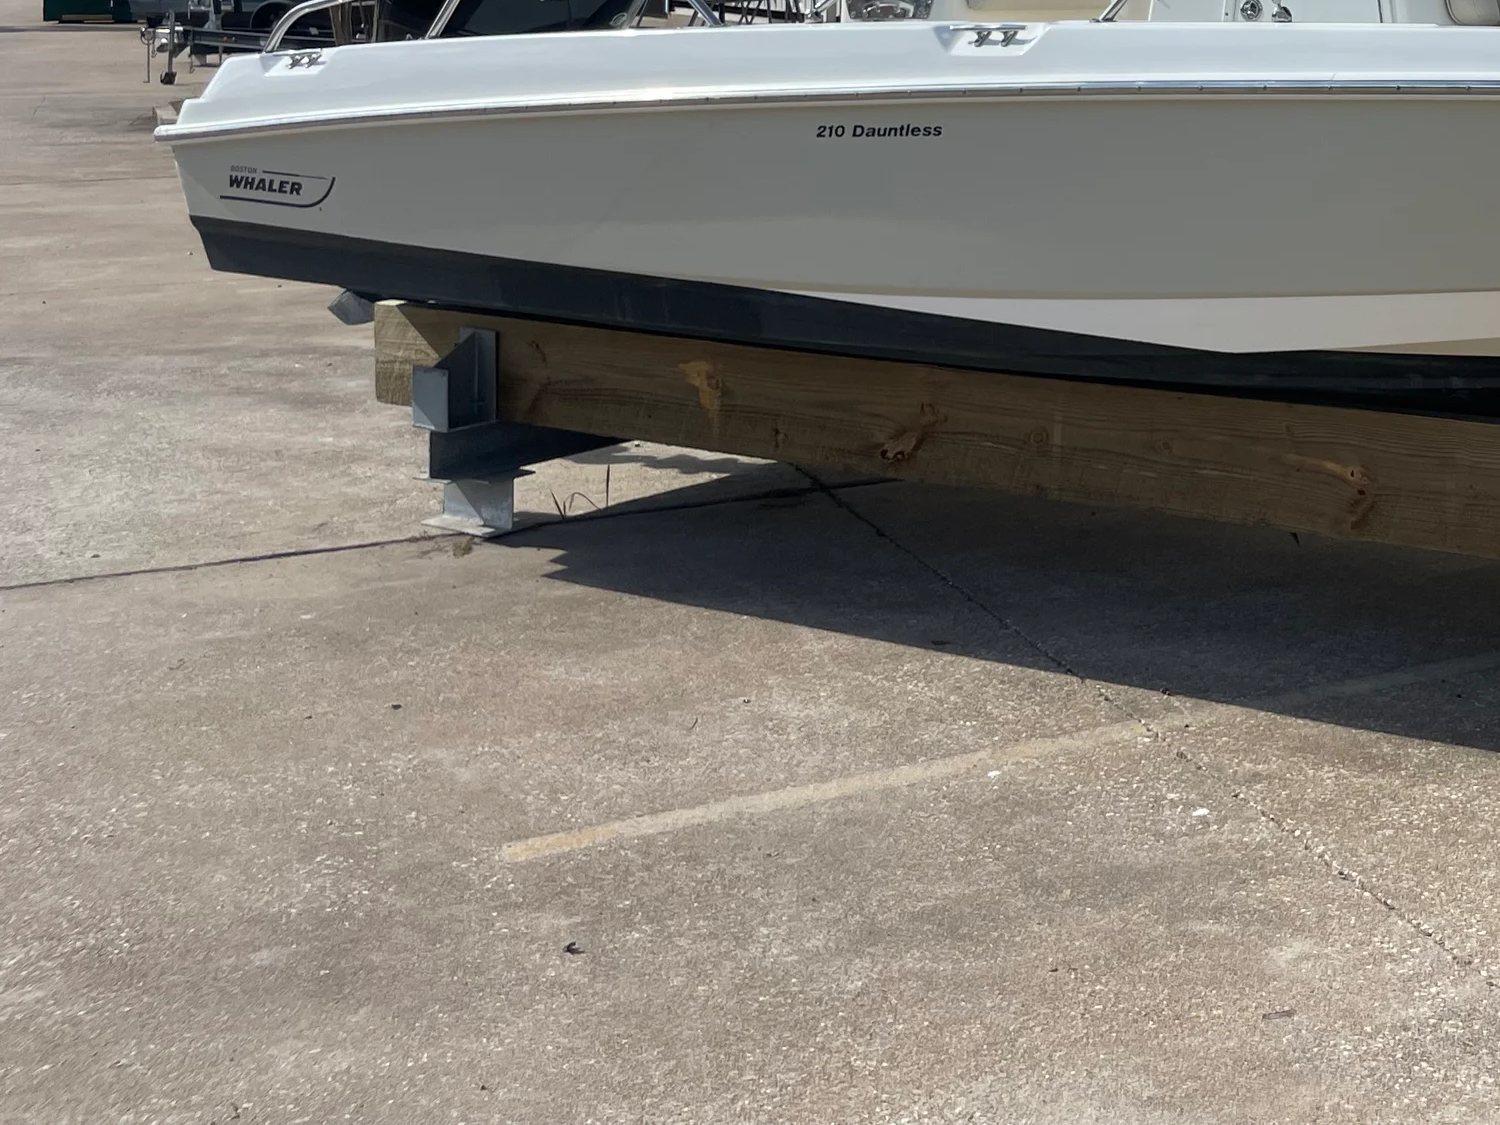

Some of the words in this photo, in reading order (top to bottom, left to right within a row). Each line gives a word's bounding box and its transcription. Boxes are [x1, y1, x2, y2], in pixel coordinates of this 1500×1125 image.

[816, 125, 845, 138] 210
[852, 123, 942, 138] Dauntless
[230, 165, 258, 174] BOSTON
[229, 174, 303, 196] WHALER
